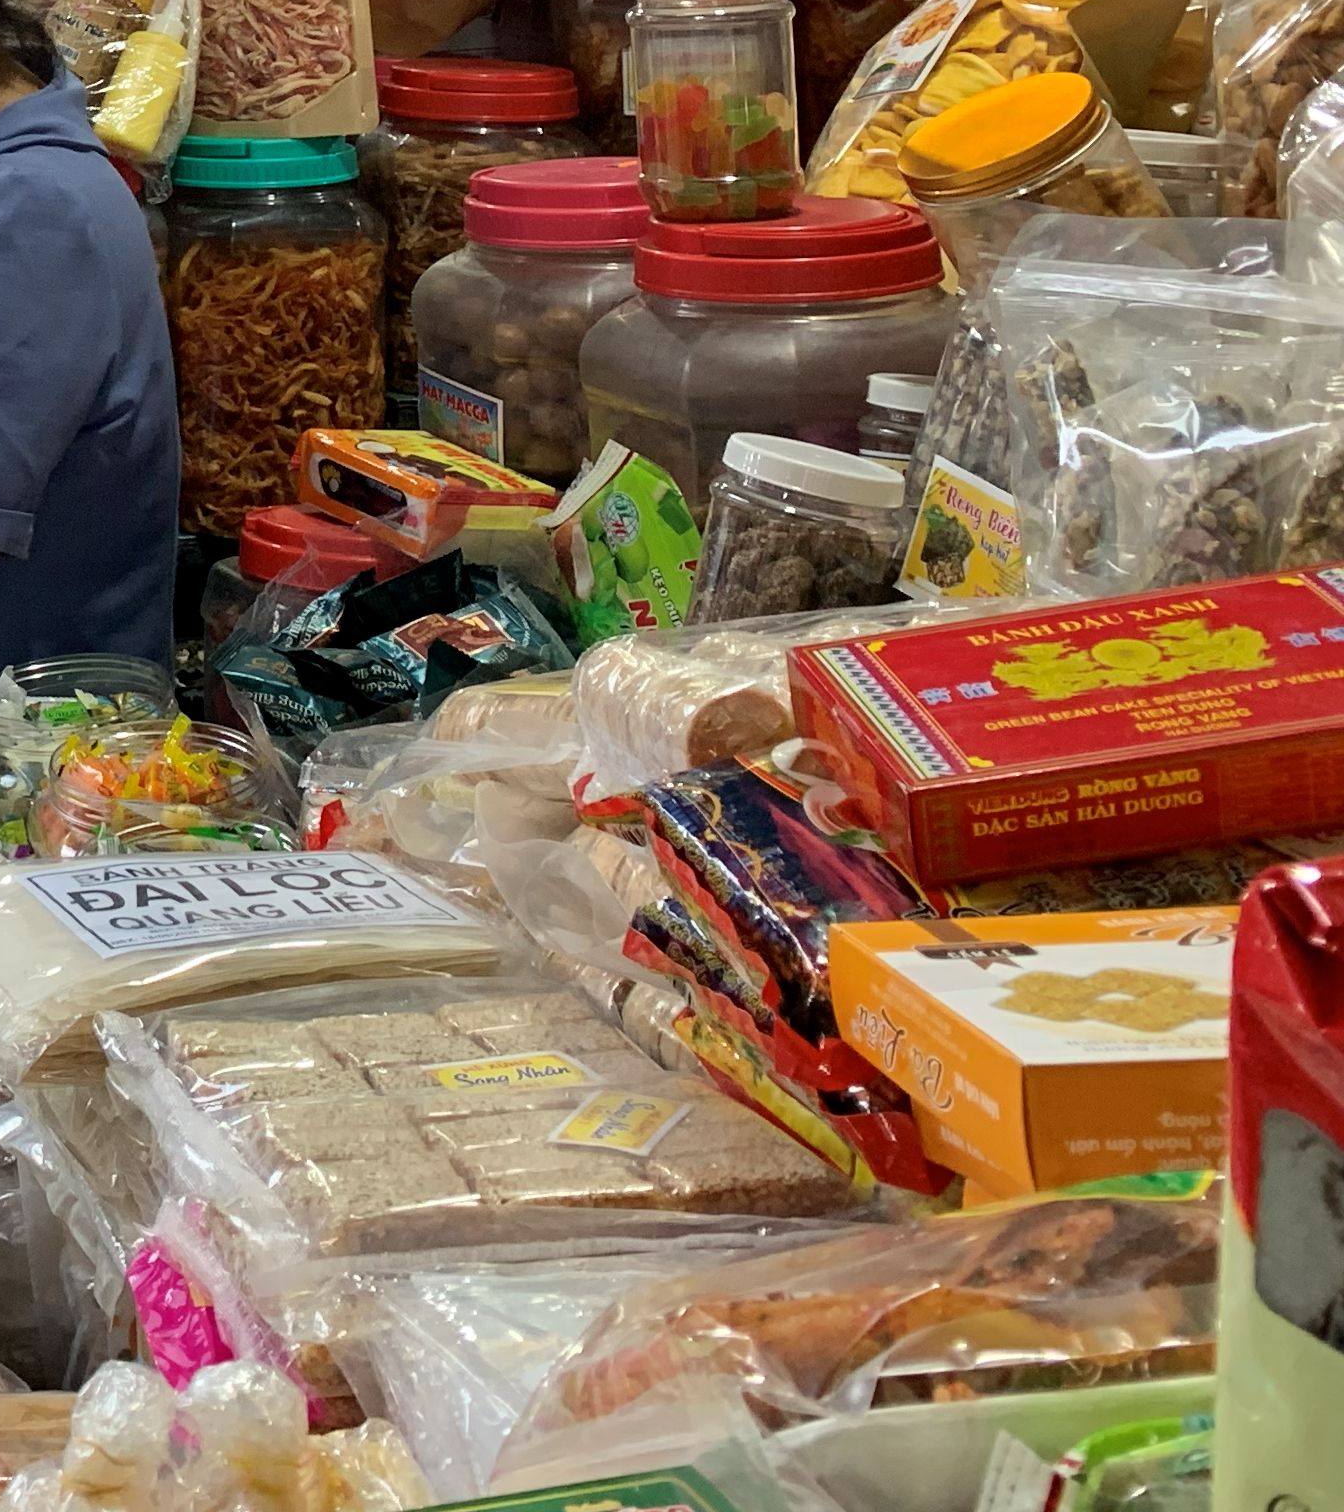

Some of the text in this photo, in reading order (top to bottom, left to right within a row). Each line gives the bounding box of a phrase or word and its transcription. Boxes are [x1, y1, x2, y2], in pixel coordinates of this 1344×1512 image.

[966, 622, 1054, 648] BÁNH
[1127, 597, 1220, 622] XANH
[984, 667, 1344, 732] GREEN BEAN CAKE SPECIALITY OF VIETNA
